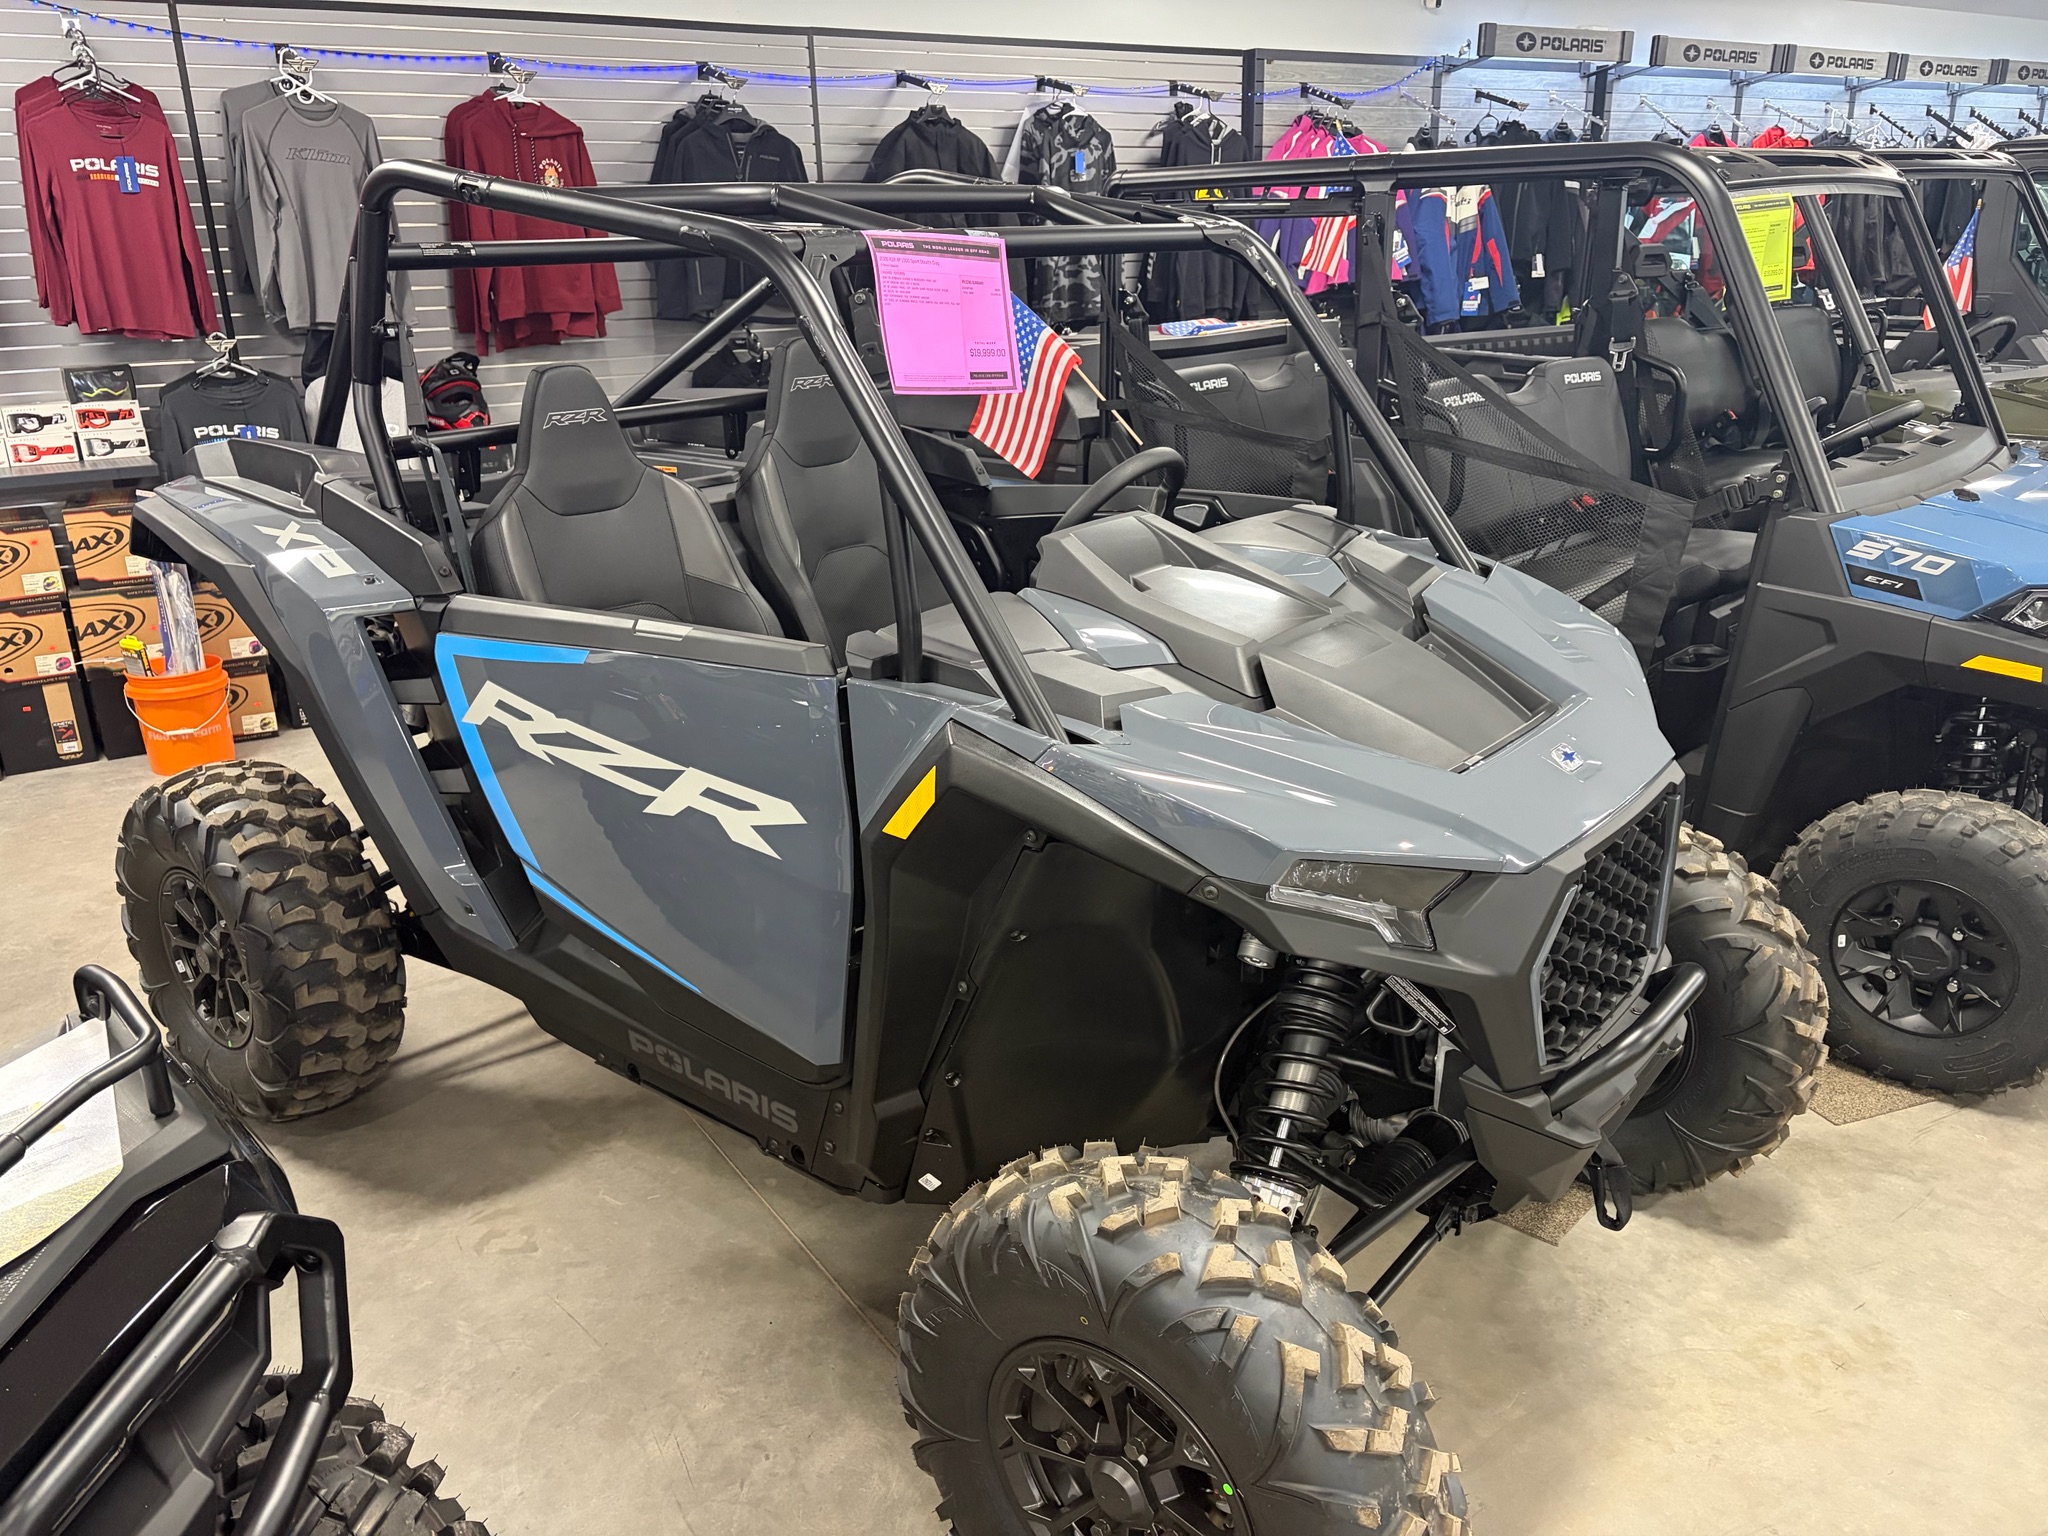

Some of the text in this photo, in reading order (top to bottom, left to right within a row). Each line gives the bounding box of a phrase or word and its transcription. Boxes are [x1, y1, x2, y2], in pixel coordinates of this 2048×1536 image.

[1540, 36, 1605, 53] POLARIS
[1703, 48, 1759, 64] POLARIS
[1826, 56, 1875, 70] POLARIS
[1934, 63, 1979, 77] POLARIS
[538, 158, 563, 173] POLARIS
[880, 240, 915, 249] POLARIS
[969, 348, 1006, 358] $19,999.00
[790, 374, 835, 392] RZR
[1190, 377, 1229, 391] OLARIS
[1563, 371, 1602, 384] POLARIS
[542, 407, 608, 430] RZR
[1845, 539, 1956, 576] 570
[1863, 575, 1905, 589] EFI
[461, 679, 808, 861] RZR
[627, 1029, 798, 1134] POLARIS
